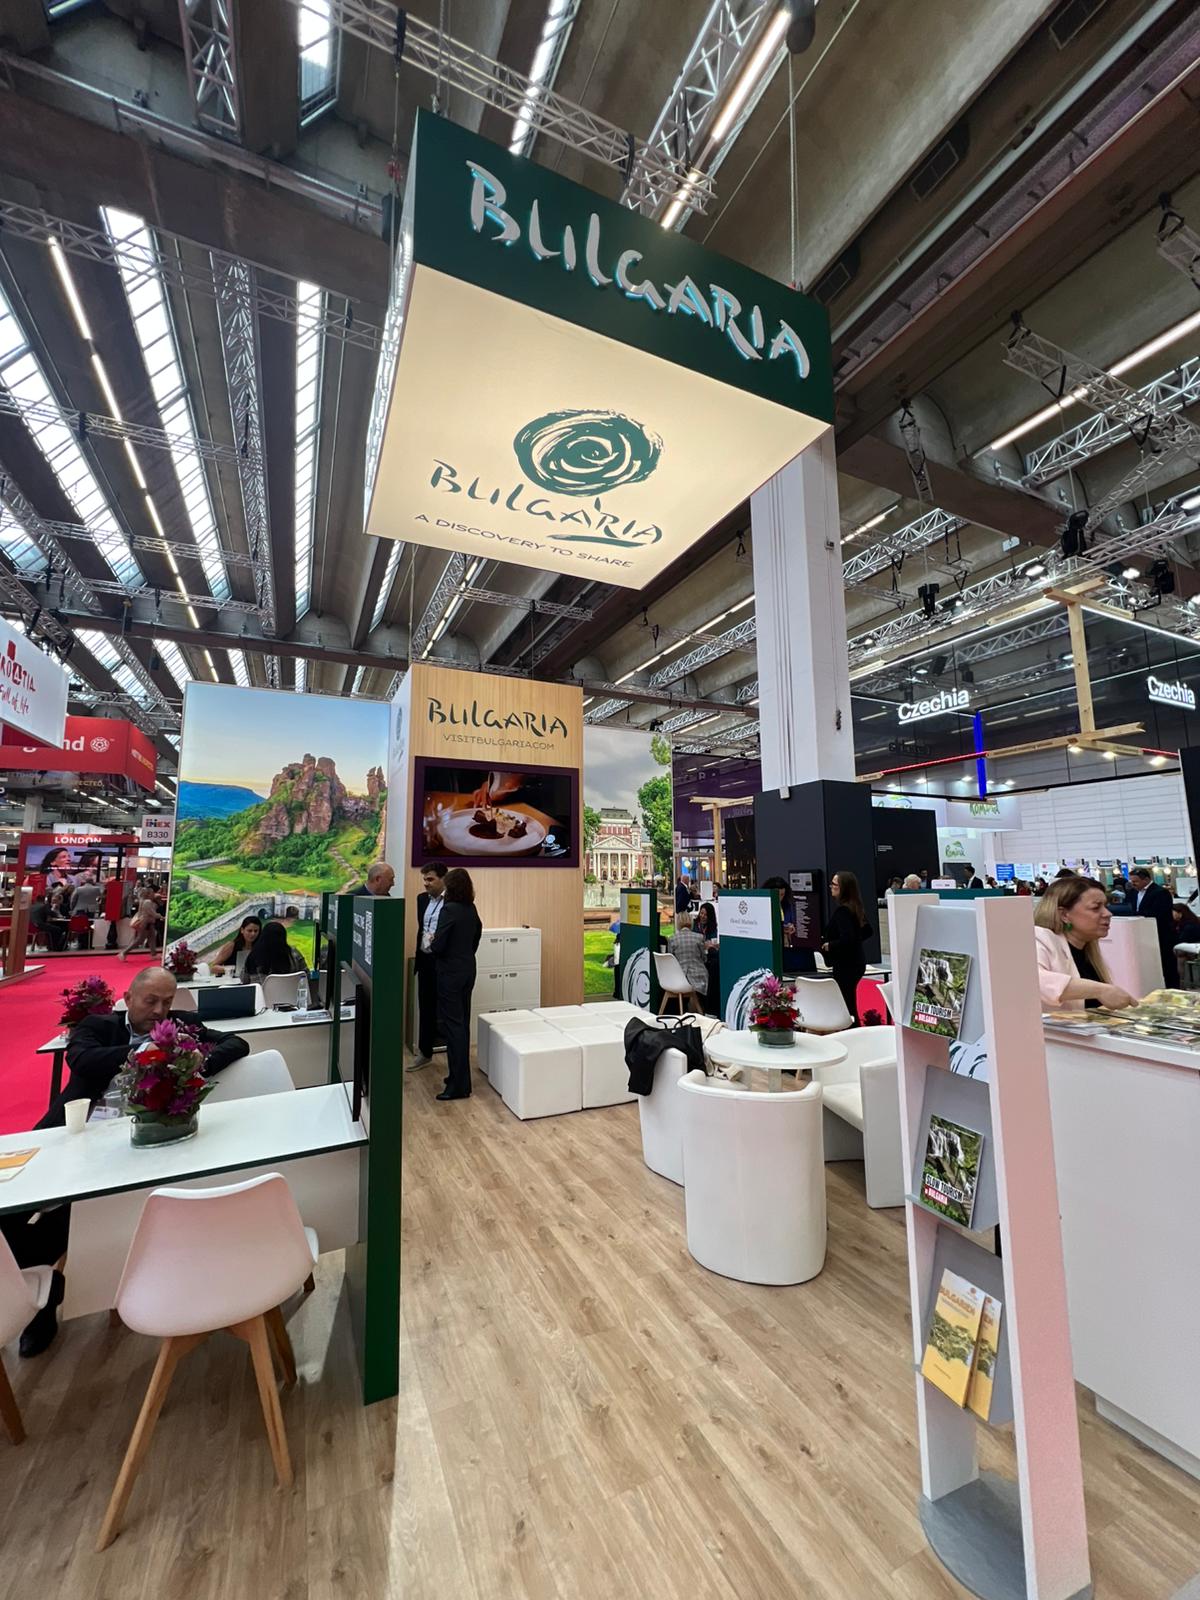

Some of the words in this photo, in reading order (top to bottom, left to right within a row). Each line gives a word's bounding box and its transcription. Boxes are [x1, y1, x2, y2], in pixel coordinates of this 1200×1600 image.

[466, 160, 810, 379] BULGARIA
[430, 459, 663, 544] BULGARIA
[414, 513, 430, 524] A
[435, 521, 547, 550] DISCOVERY
[549, 545, 574, 557] TO
[576, 550, 635, 568] SHARE
[0, 652, 36, 692] ROATIA
[898, 688, 970, 721] Czechia
[1148, 675, 1196, 705] Czechia
[427, 697, 568, 739] BULGARIA
[54, 836, 102, 845] LONDON
[147, 831, 169, 839] B330
[930, 1004, 952, 1019] TOURISM
[926, 1174, 941, 1190] SLOW
[941, 1182, 964, 1203] TOURISM
